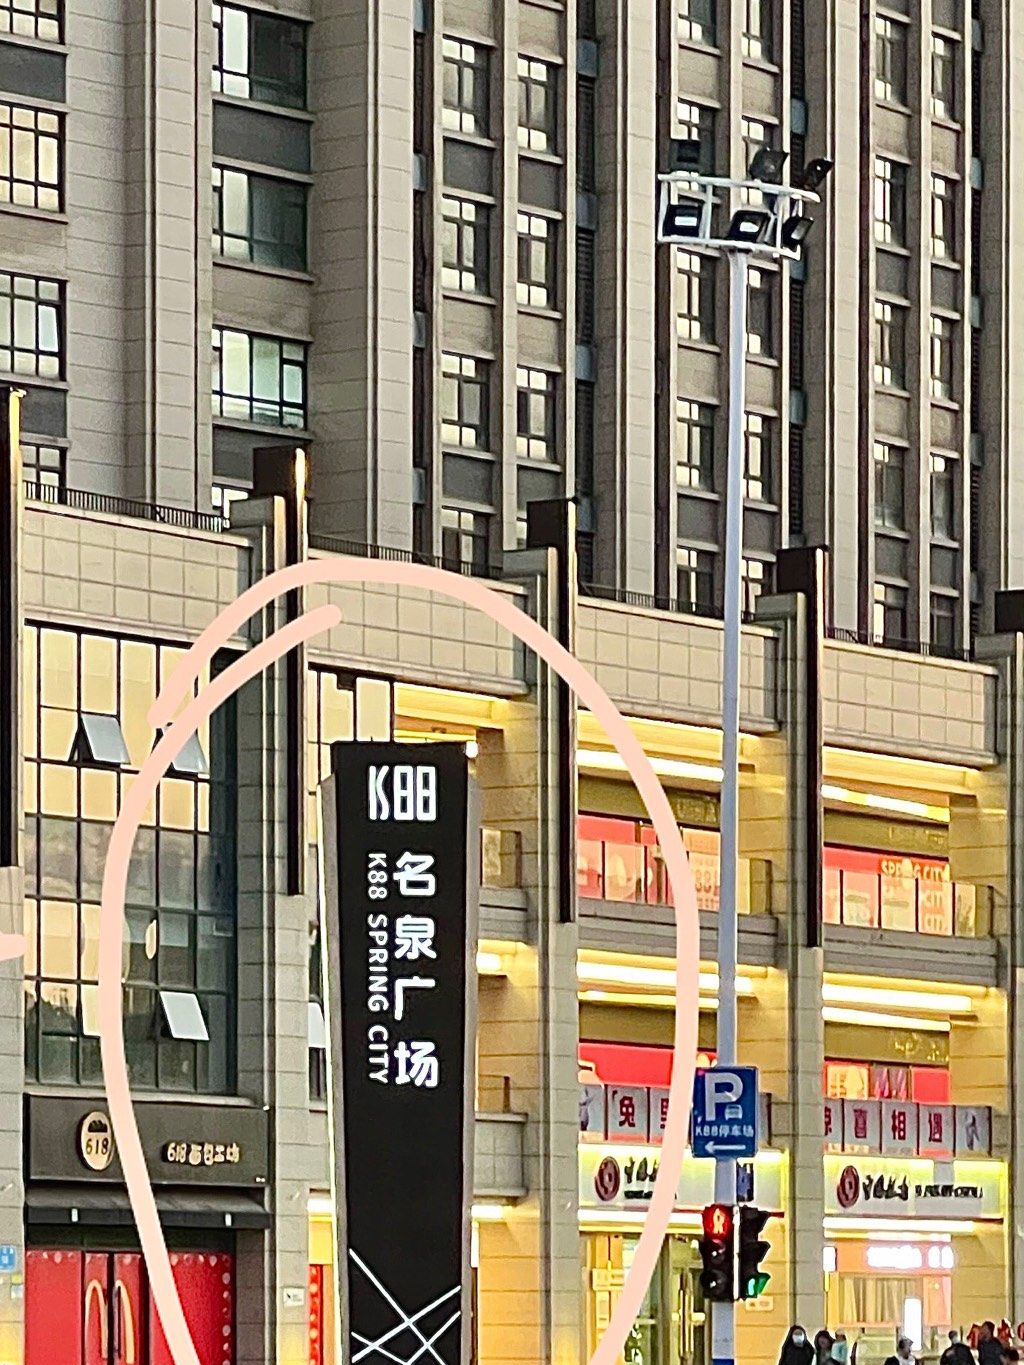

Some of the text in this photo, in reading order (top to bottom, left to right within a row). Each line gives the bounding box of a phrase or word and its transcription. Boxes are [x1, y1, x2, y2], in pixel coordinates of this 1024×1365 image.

[367, 852, 389, 1085] K88 SPRING CITY
[392, 851, 440, 1088] 名泉广场
[86, 1137, 109, 1155] 618
[705, 1072, 743, 1121] P
